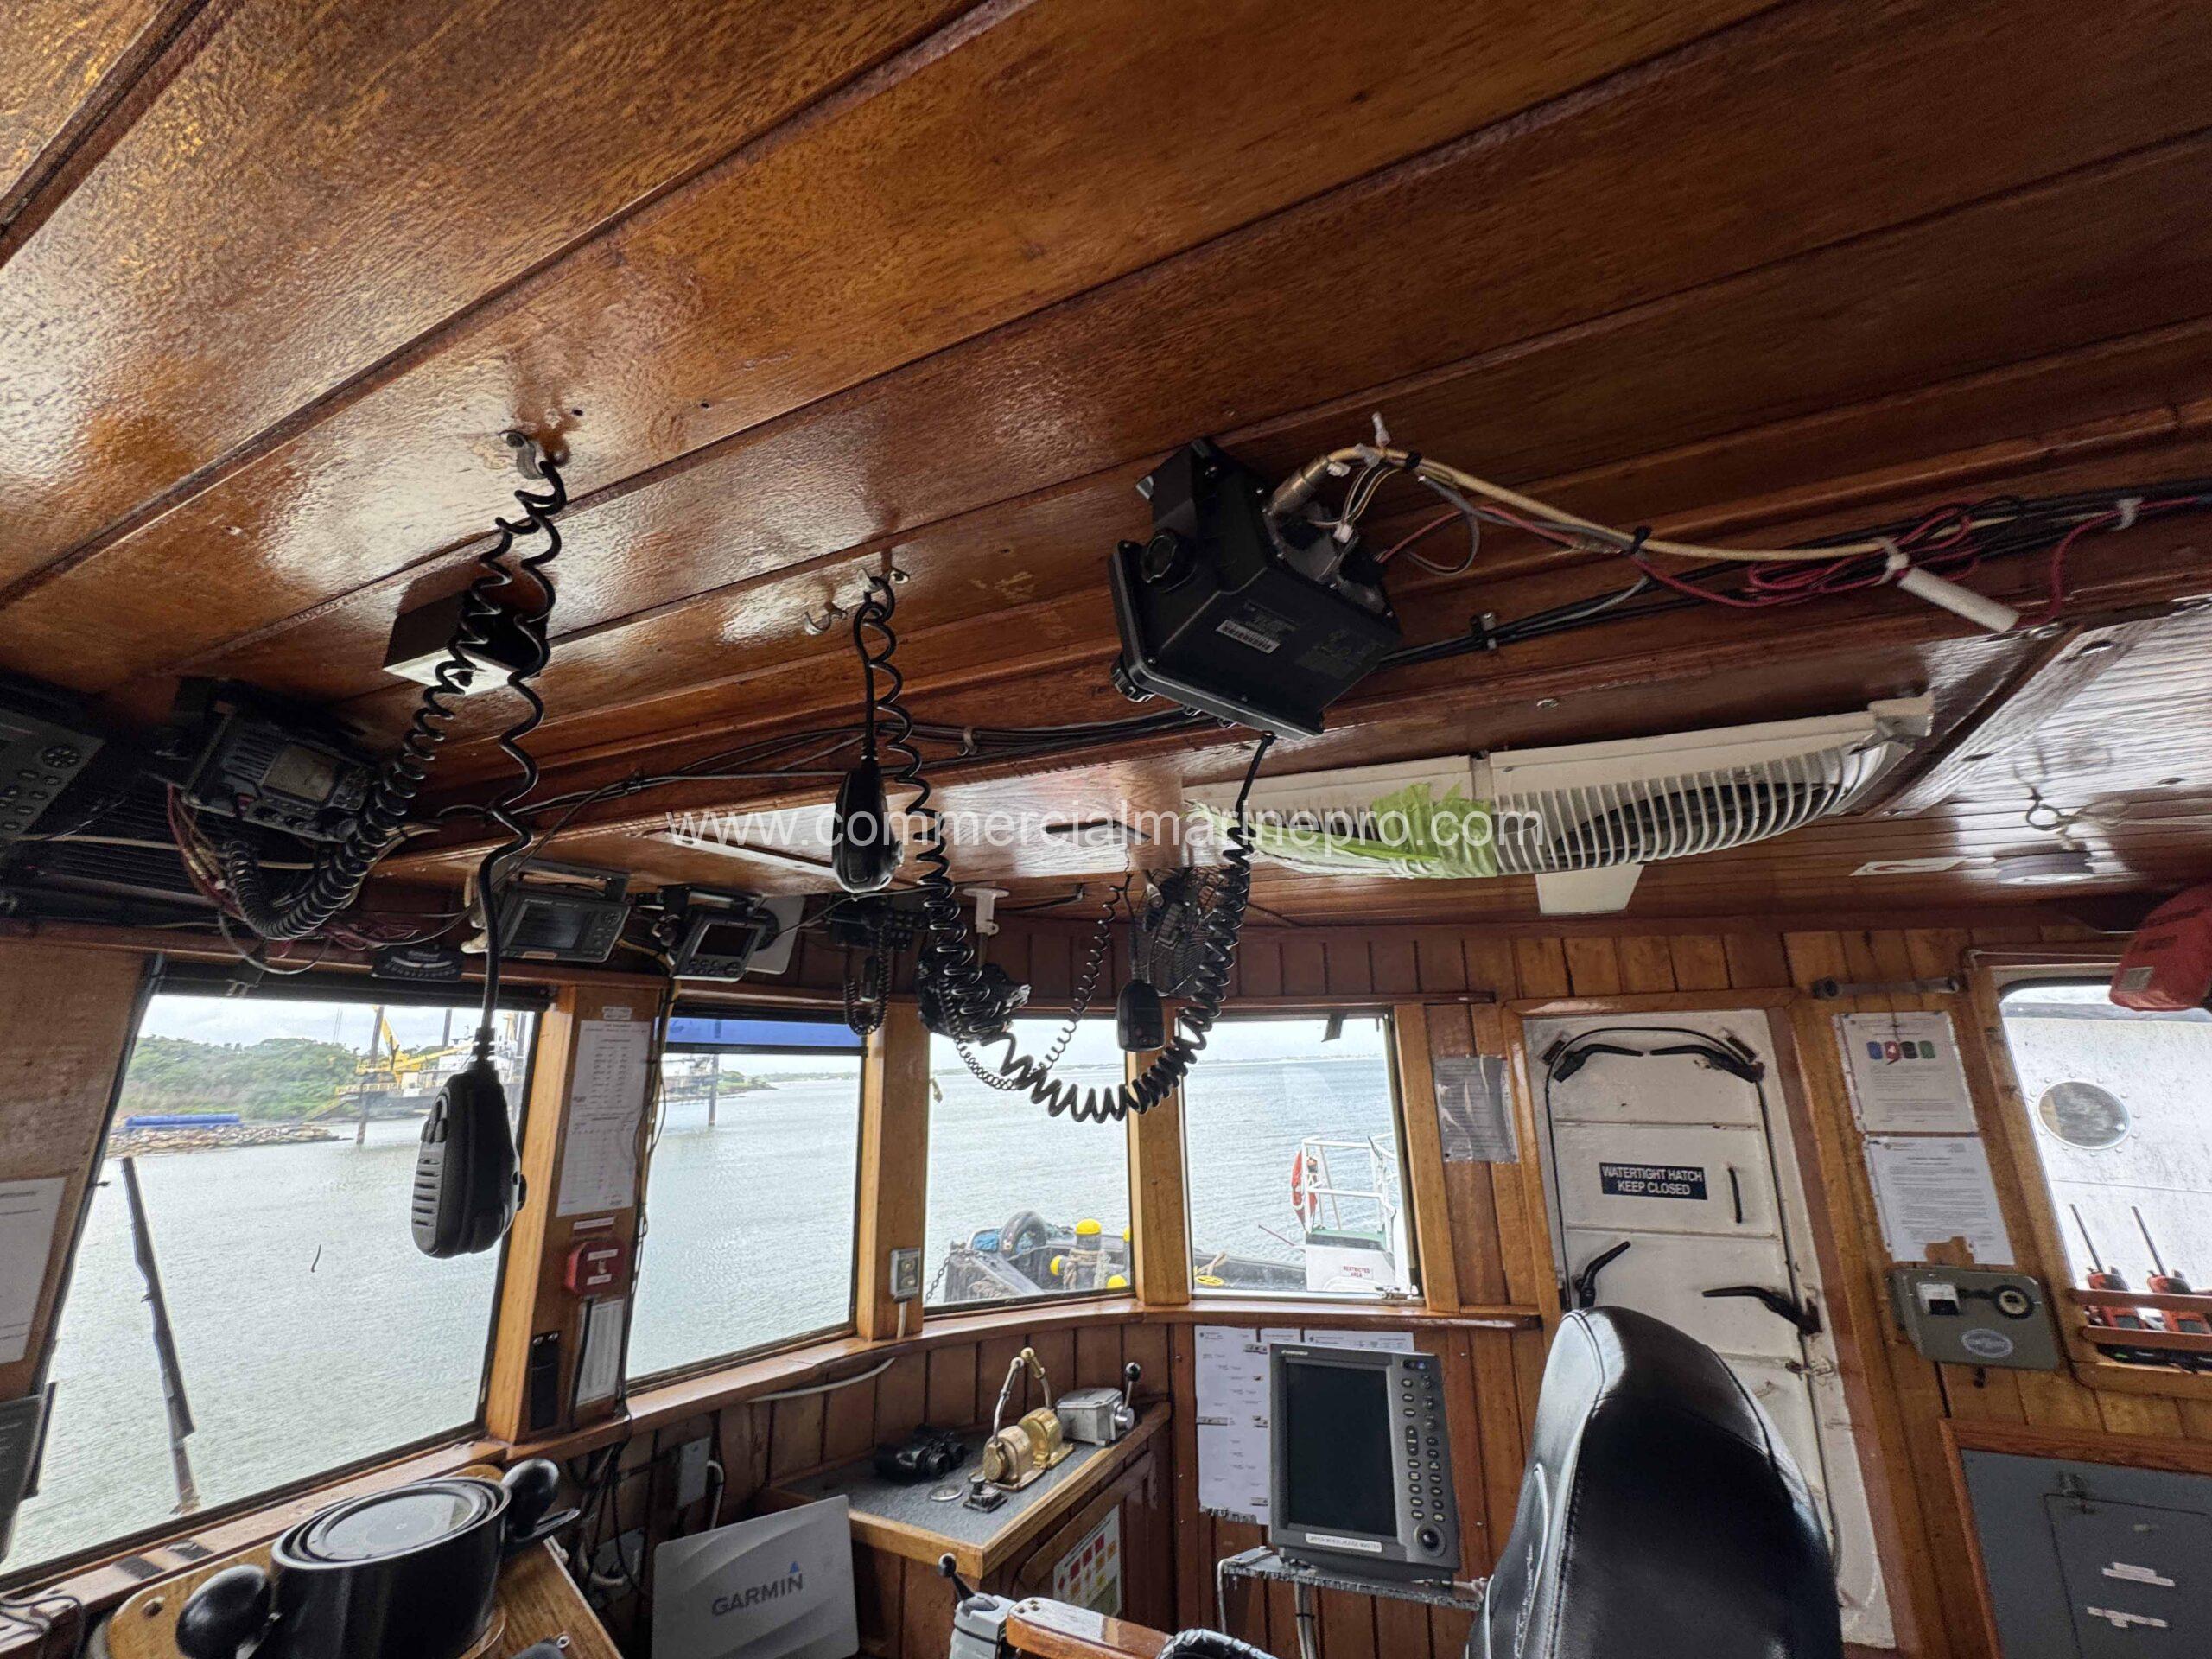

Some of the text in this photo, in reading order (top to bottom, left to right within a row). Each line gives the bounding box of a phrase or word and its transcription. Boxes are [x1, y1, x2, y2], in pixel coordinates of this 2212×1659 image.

[1602, 1166, 1703, 1182] WATERTIGHT HATCH
[1618, 1180, 1691, 1195] KEEP CLOSED
[711, 1573, 804, 1616] GARMIN
